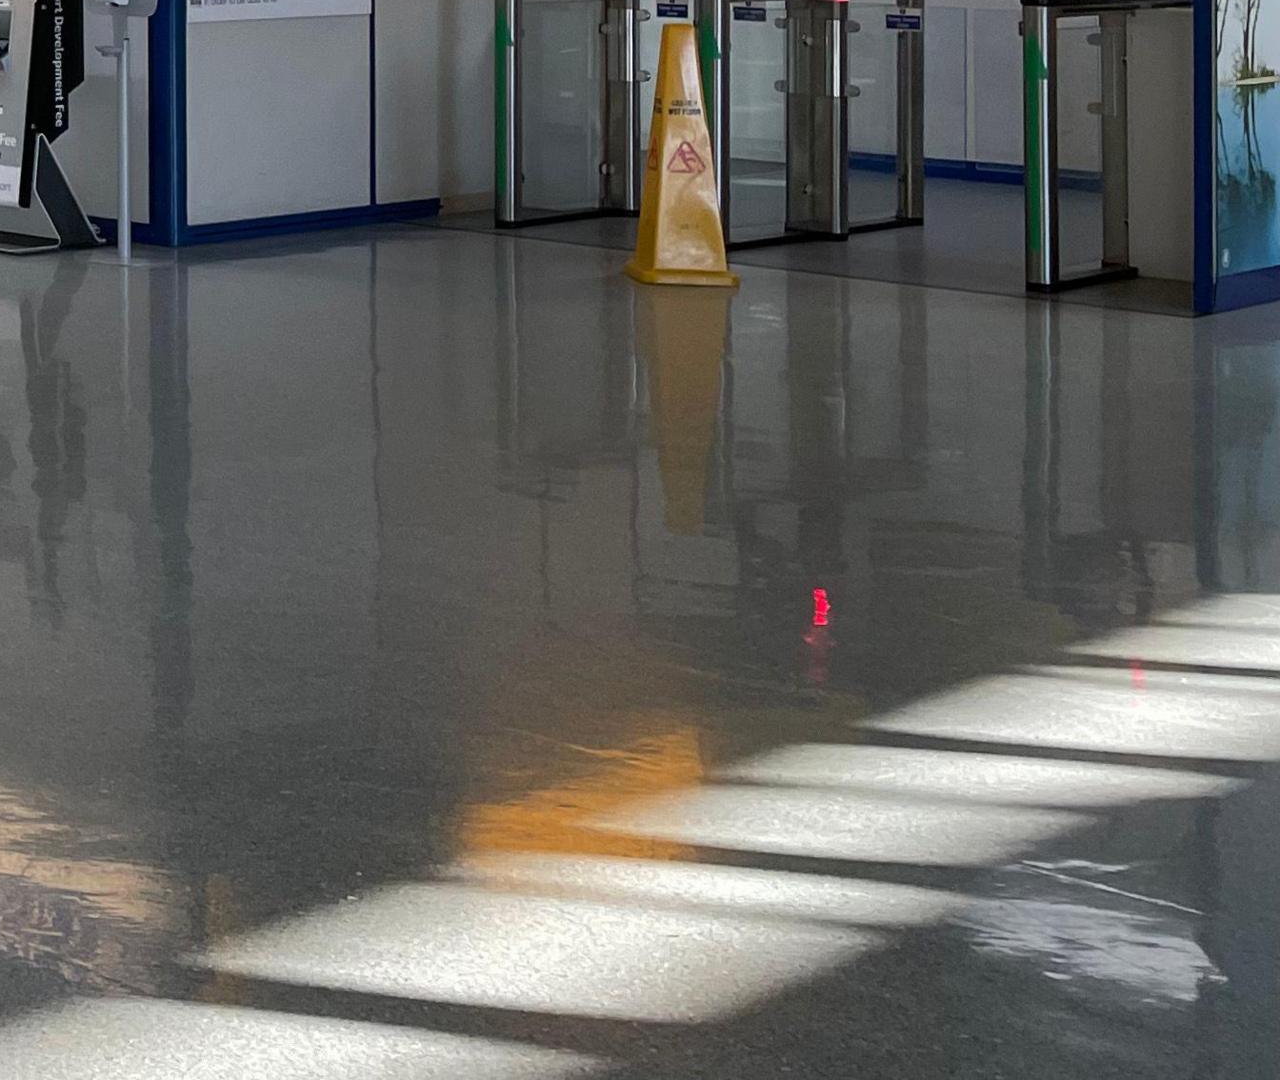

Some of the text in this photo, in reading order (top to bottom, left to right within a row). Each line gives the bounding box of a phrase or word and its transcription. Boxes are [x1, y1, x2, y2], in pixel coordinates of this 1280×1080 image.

[52, 16, 65, 102] Development
[55, 104, 65, 128] Fee
[0, 132, 17, 147] Fee
